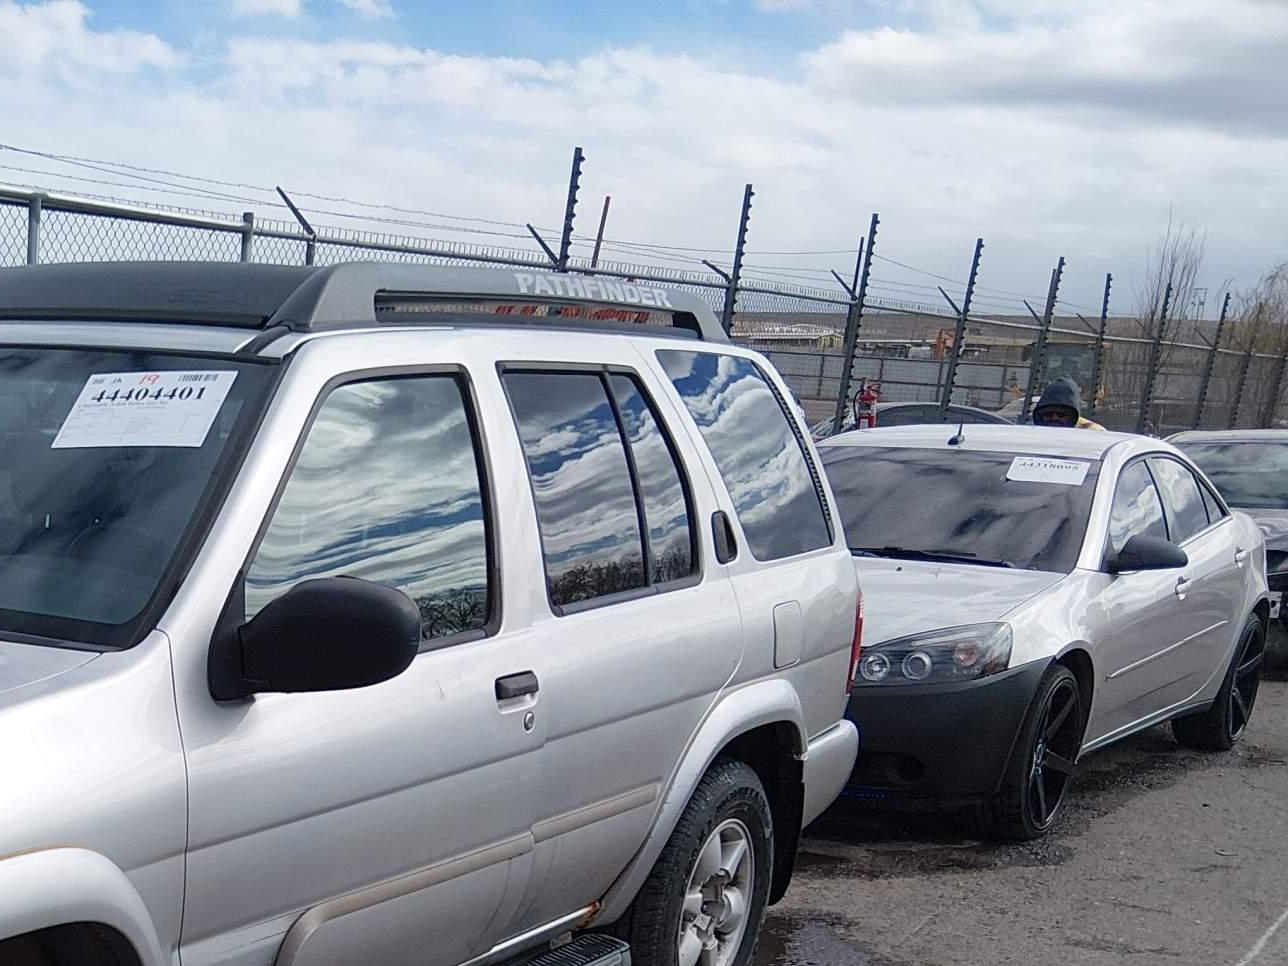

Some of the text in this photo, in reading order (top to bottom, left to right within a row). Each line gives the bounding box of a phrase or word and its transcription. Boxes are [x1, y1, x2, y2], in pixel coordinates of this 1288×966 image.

[514, 273, 672, 308] PATHFINDER
[137, 374, 160, 385] 19
[90, 386, 207, 403] 44404401
